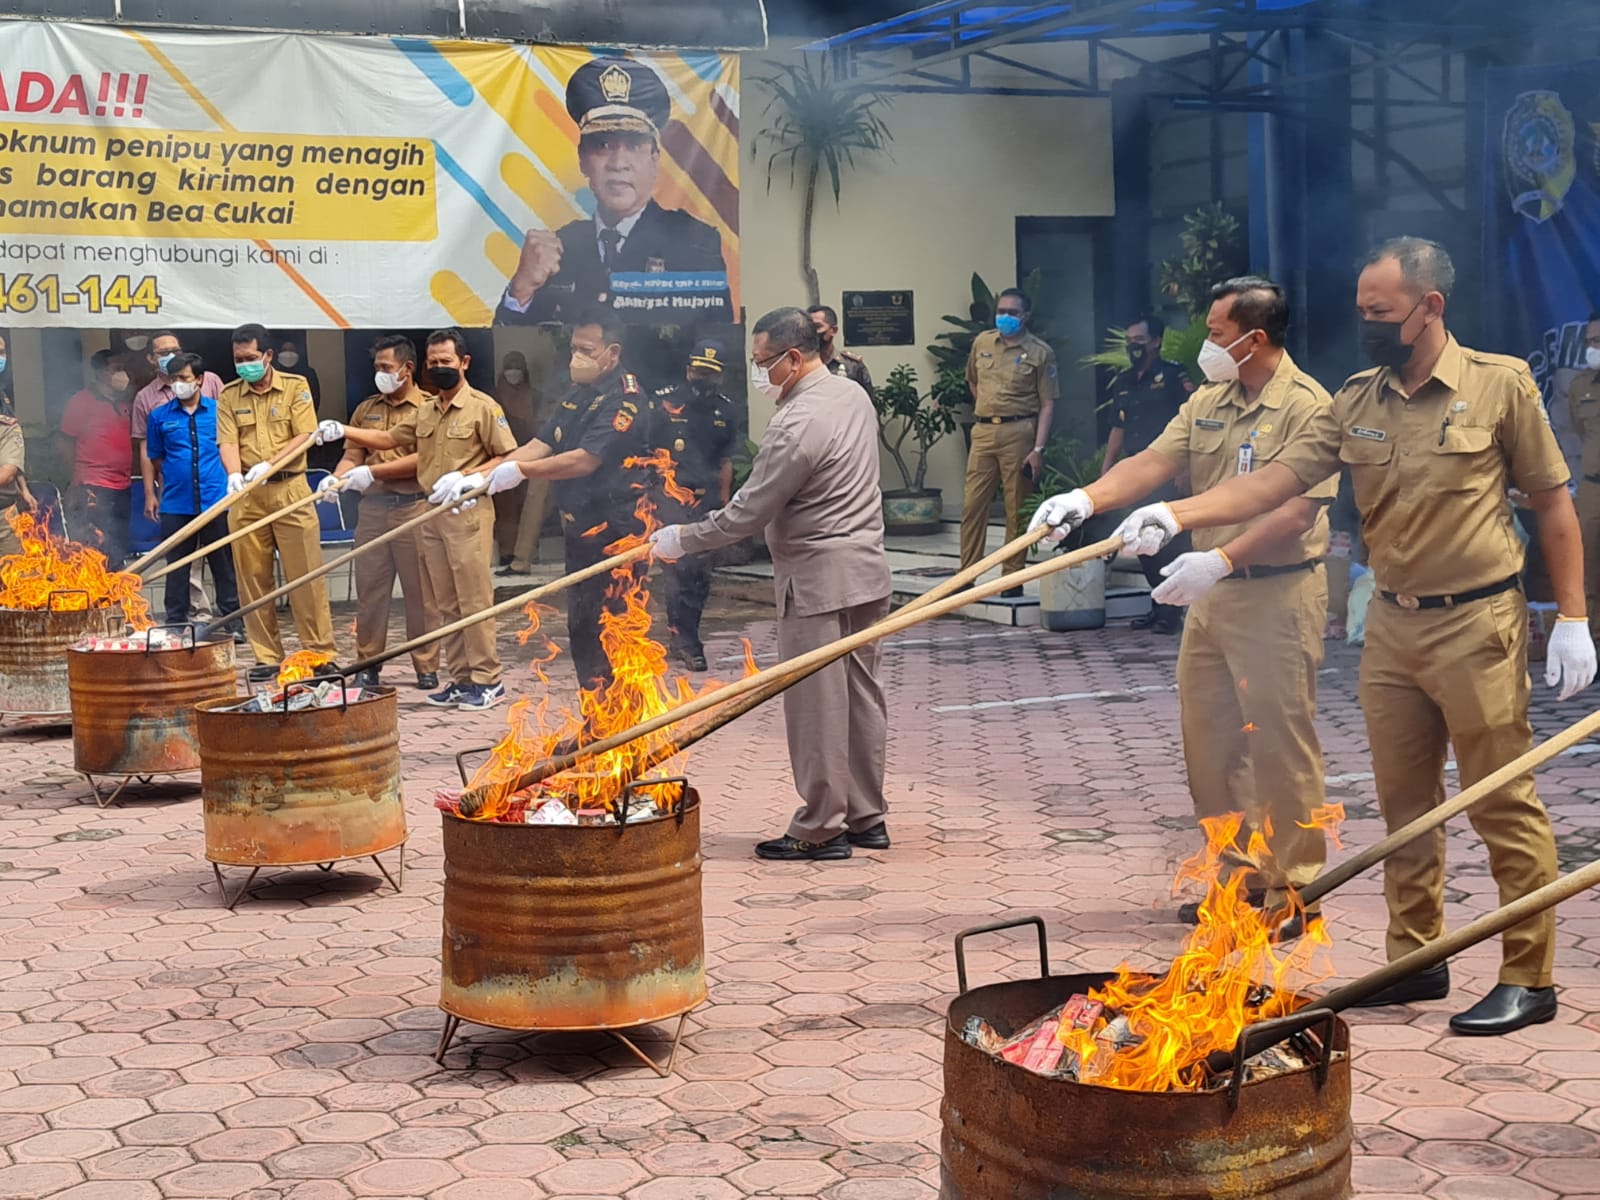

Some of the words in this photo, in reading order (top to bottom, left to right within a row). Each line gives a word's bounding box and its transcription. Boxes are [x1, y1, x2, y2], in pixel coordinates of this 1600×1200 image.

[105, 134, 211, 163] penipu
[221, 142, 294, 168] yang
[301, 142, 424, 171] menagih
[36, 163, 156, 195] barang
[178, 167, 294, 193] kiriman
[316, 172, 425, 201] dengan
[147, 201, 204, 222] Bea
[214, 200, 295, 224] Cukai
[74, 243, 239, 267] menghubungi
[247, 245, 301, 264] kami
[308, 246, 328, 265] di
[0, 273, 162, 314] 61-144
